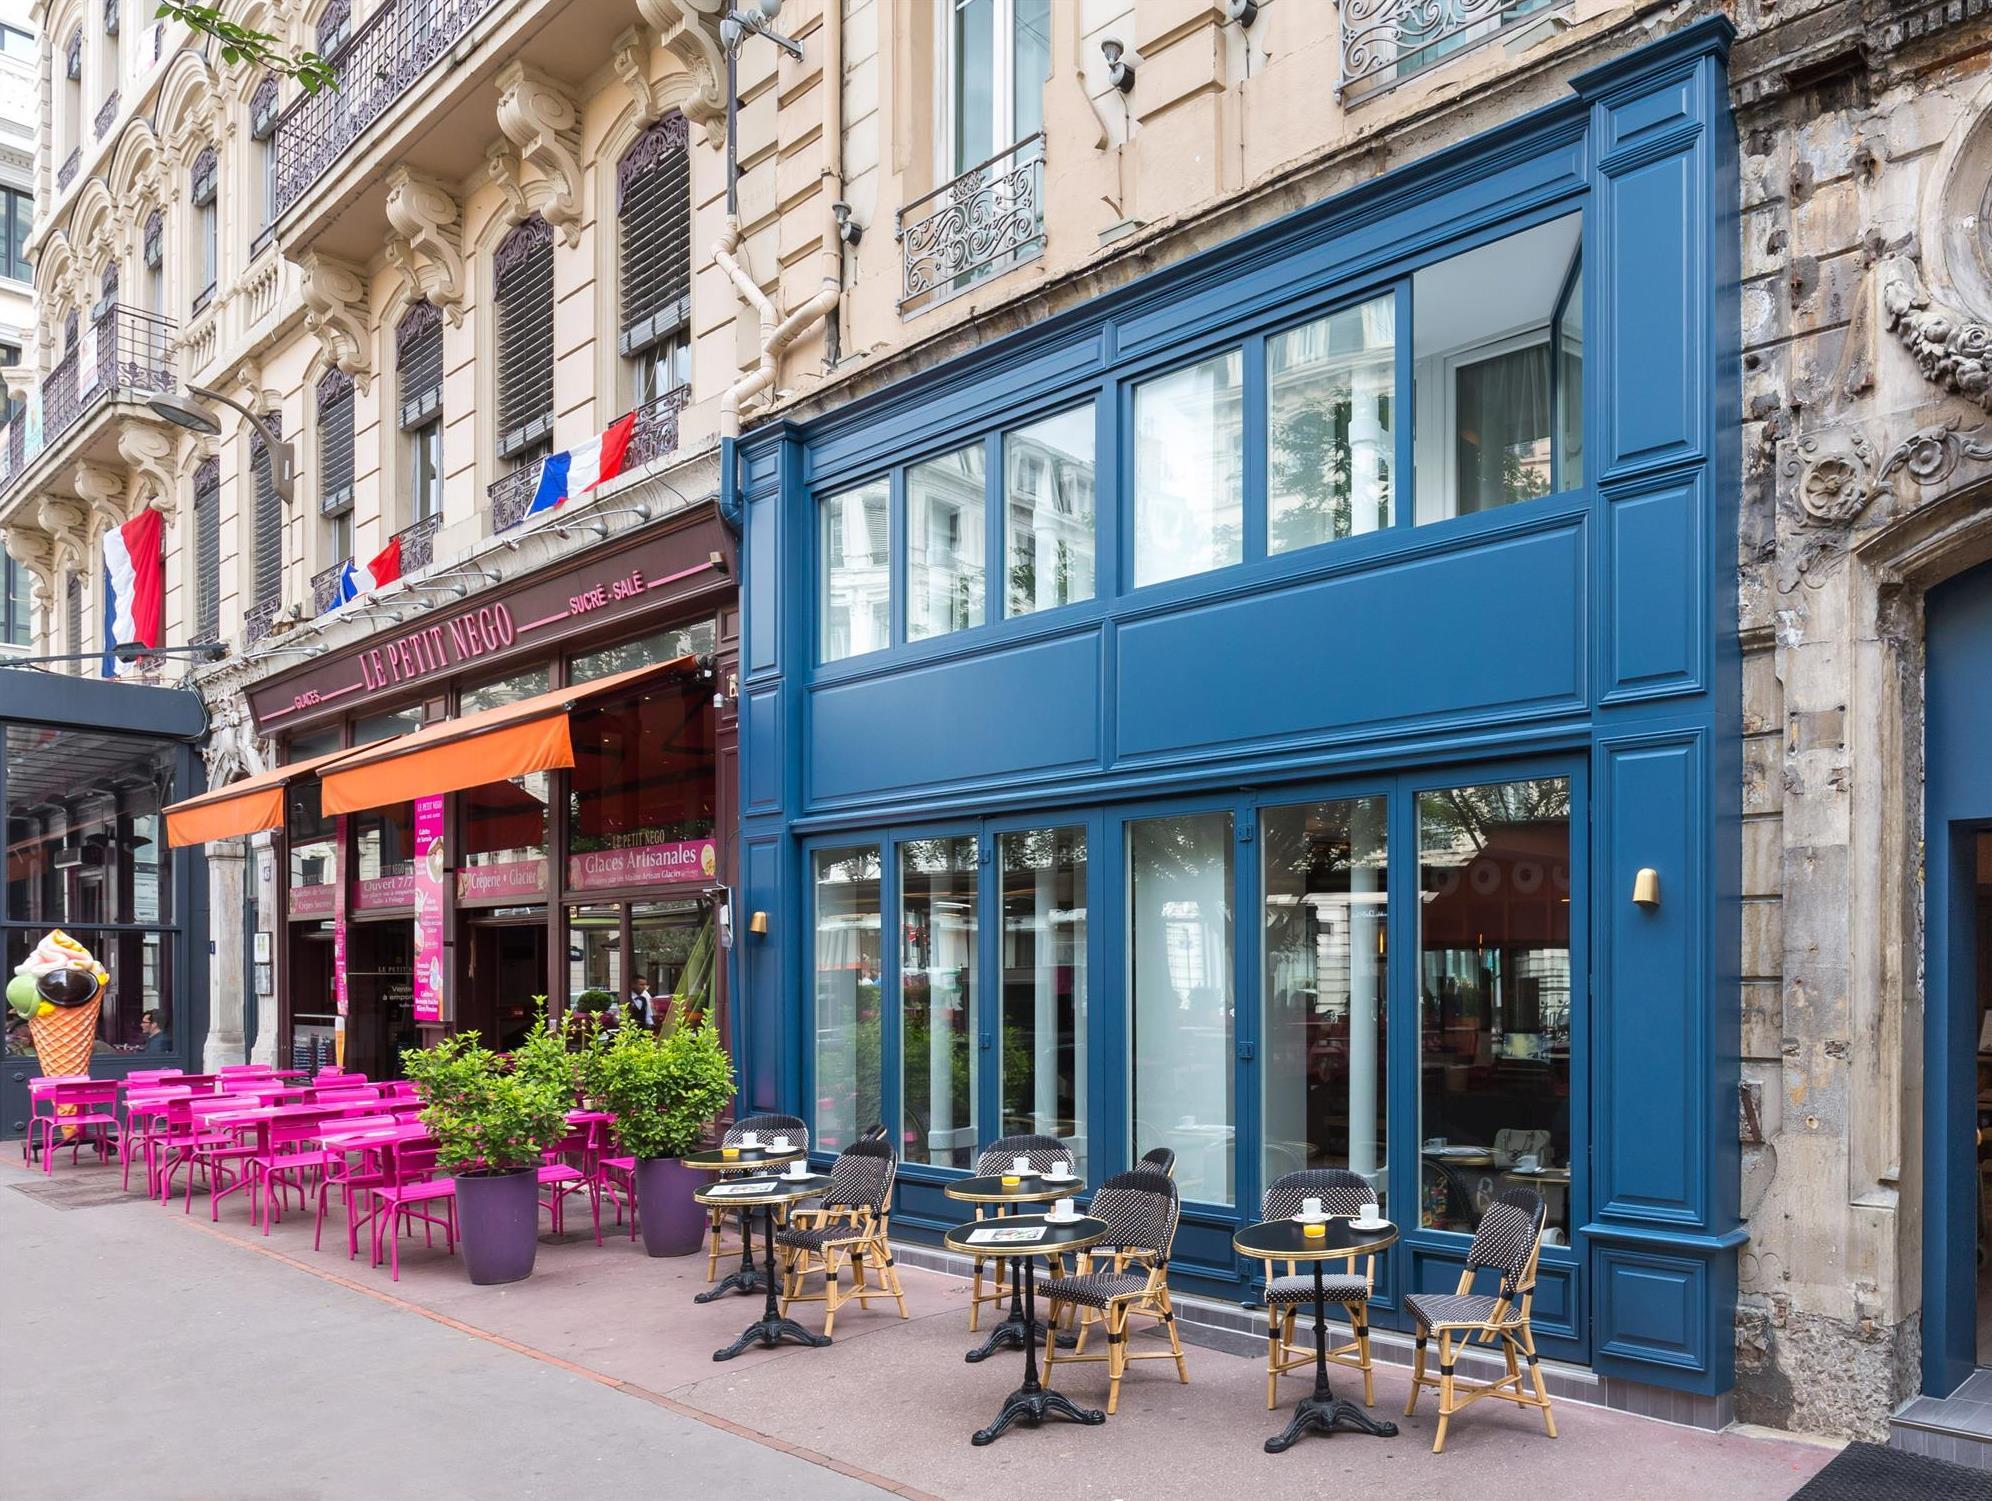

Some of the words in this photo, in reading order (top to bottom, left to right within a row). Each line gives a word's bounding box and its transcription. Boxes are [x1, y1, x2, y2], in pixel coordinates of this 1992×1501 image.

[359, 650, 387, 691] LE
[386, 626, 449, 682] PETIT
[448, 602, 514, 661] NEGO
[294, 689, 320, 709] GLACES
[622, 831, 644, 847] PETIT
[645, 829, 665, 844] NEGO
[585, 855, 624, 874] Glaces
[626, 844, 697, 869] Artisanales
[363, 878, 395, 892] Ouvert
[398, 876, 414, 888] 7/7
[471, 871, 501, 893] Crêperie
